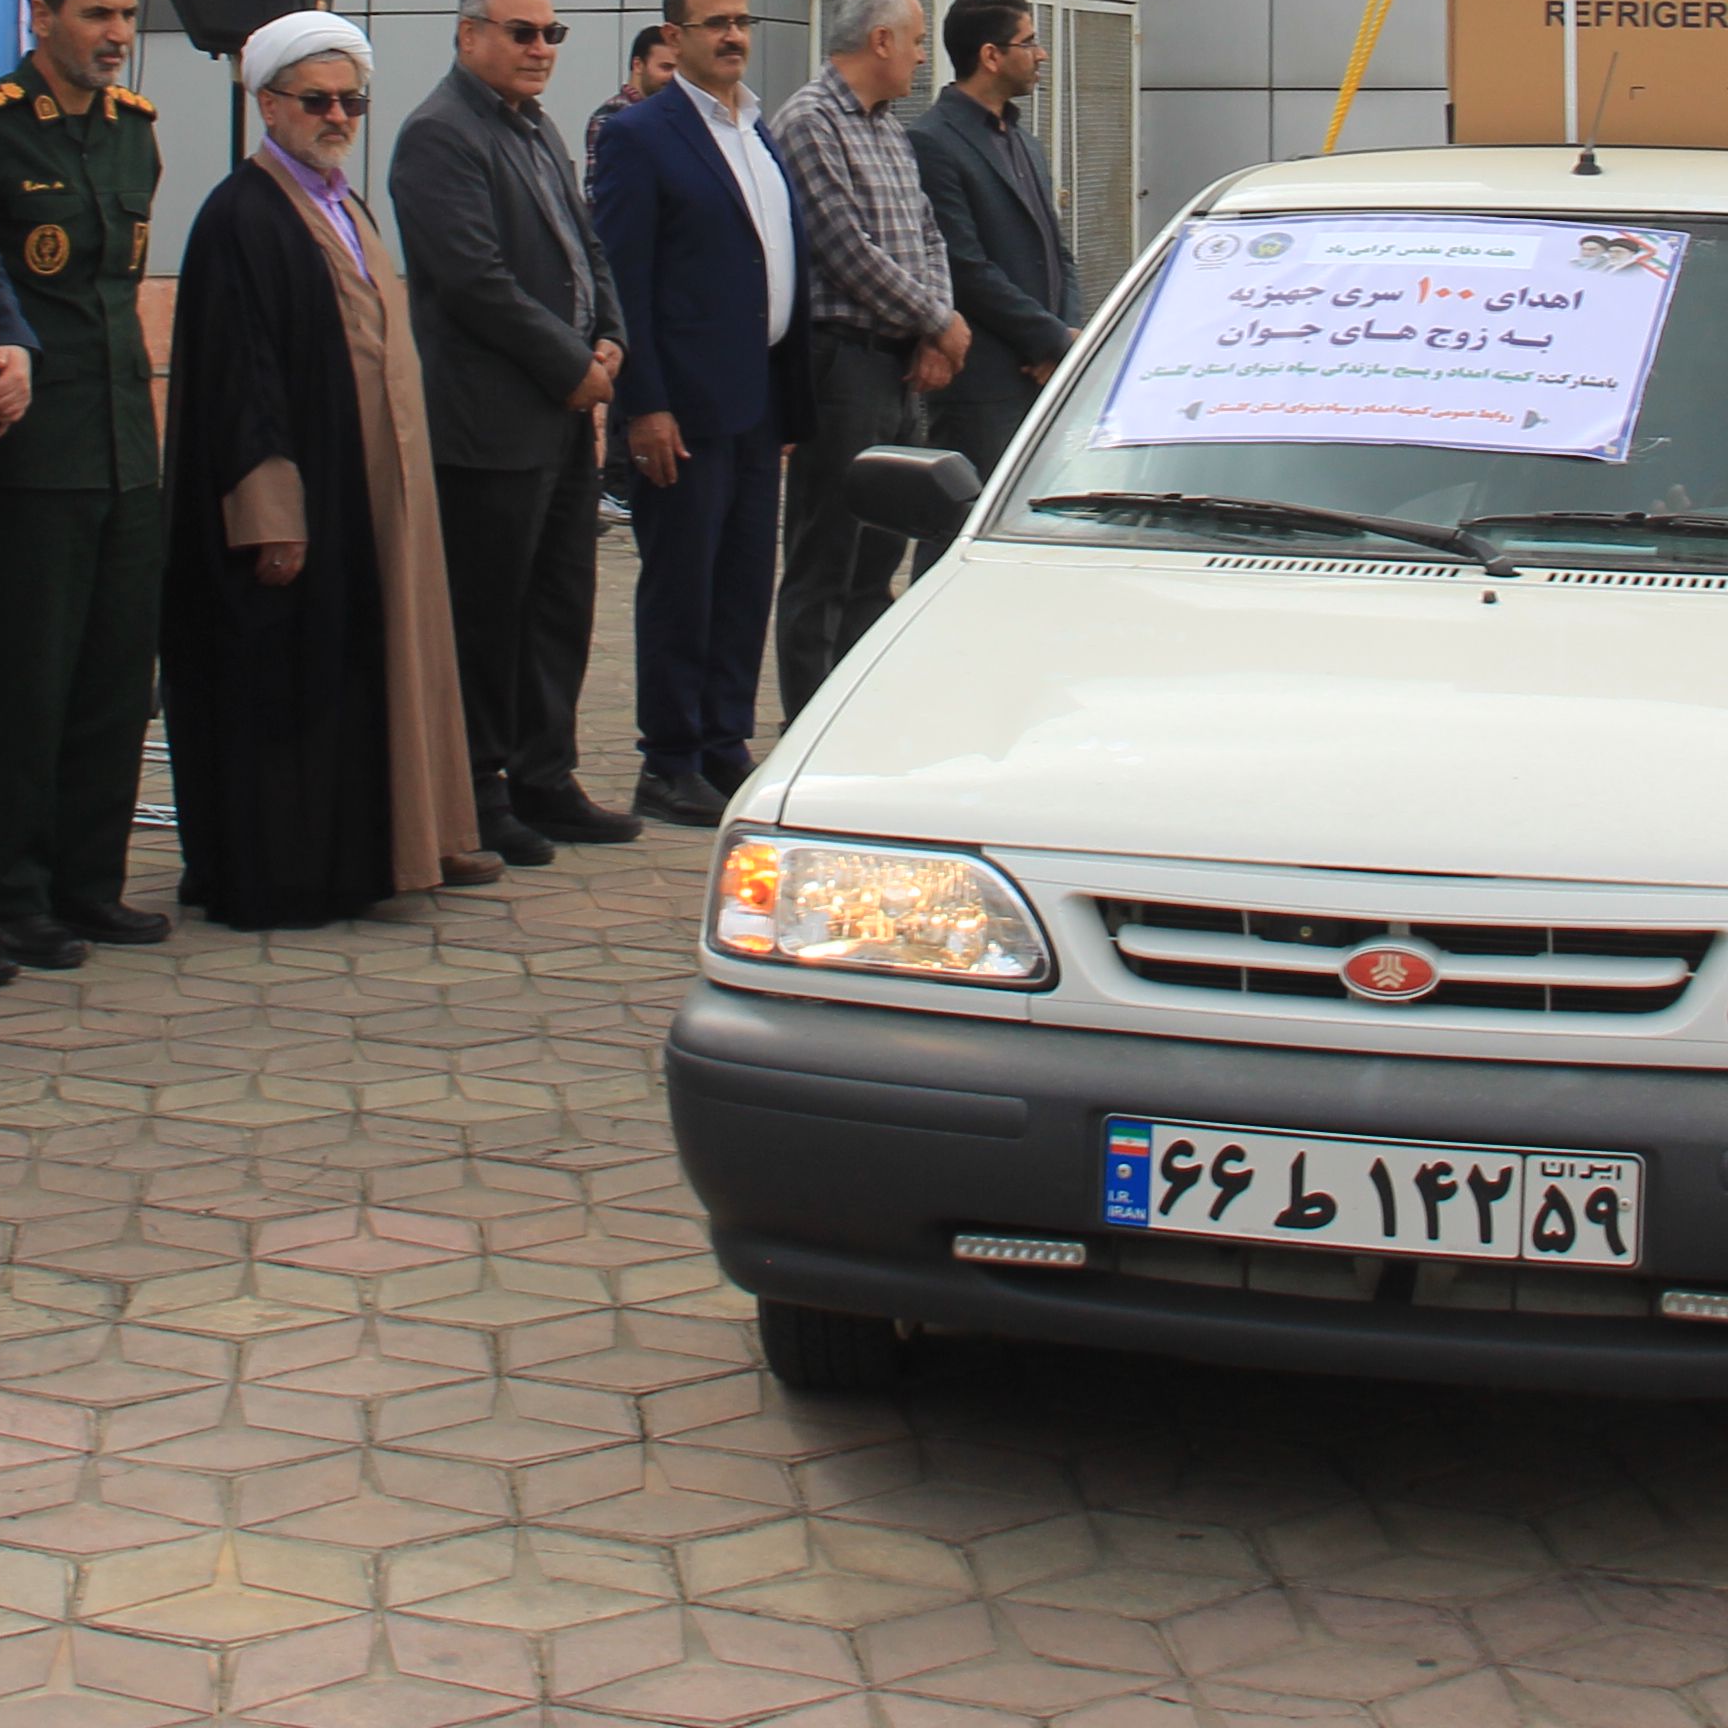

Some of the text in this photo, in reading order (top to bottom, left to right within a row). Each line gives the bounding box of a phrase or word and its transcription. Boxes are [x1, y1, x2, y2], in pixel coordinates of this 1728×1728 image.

[1395, 244, 1442, 257] مقدس
[1228, 276, 1585, 312] اهدای ۱۰۰ سری جهیزیه
[1216, 319, 1553, 354] به زوج های جوان
[1192, 363, 1237, 378] استان
[1285, 361, 1319, 376] سپاه
[1320, 362, 1390, 378] سازندگی
[1392, 366, 1431, 380] بسیج
[1445, 368, 1491, 380] امداد
[1490, 369, 1536, 384] کمیته
[1540, 1160, 1623, 1180] ایران
[1274, 1150, 1338, 1230] ط
[1369, 1157, 1514, 1244] ۱۴۲
[1107, 1204, 1147, 1221] IRAN
[1532, 1183, 1627, 1256] ۵۹
